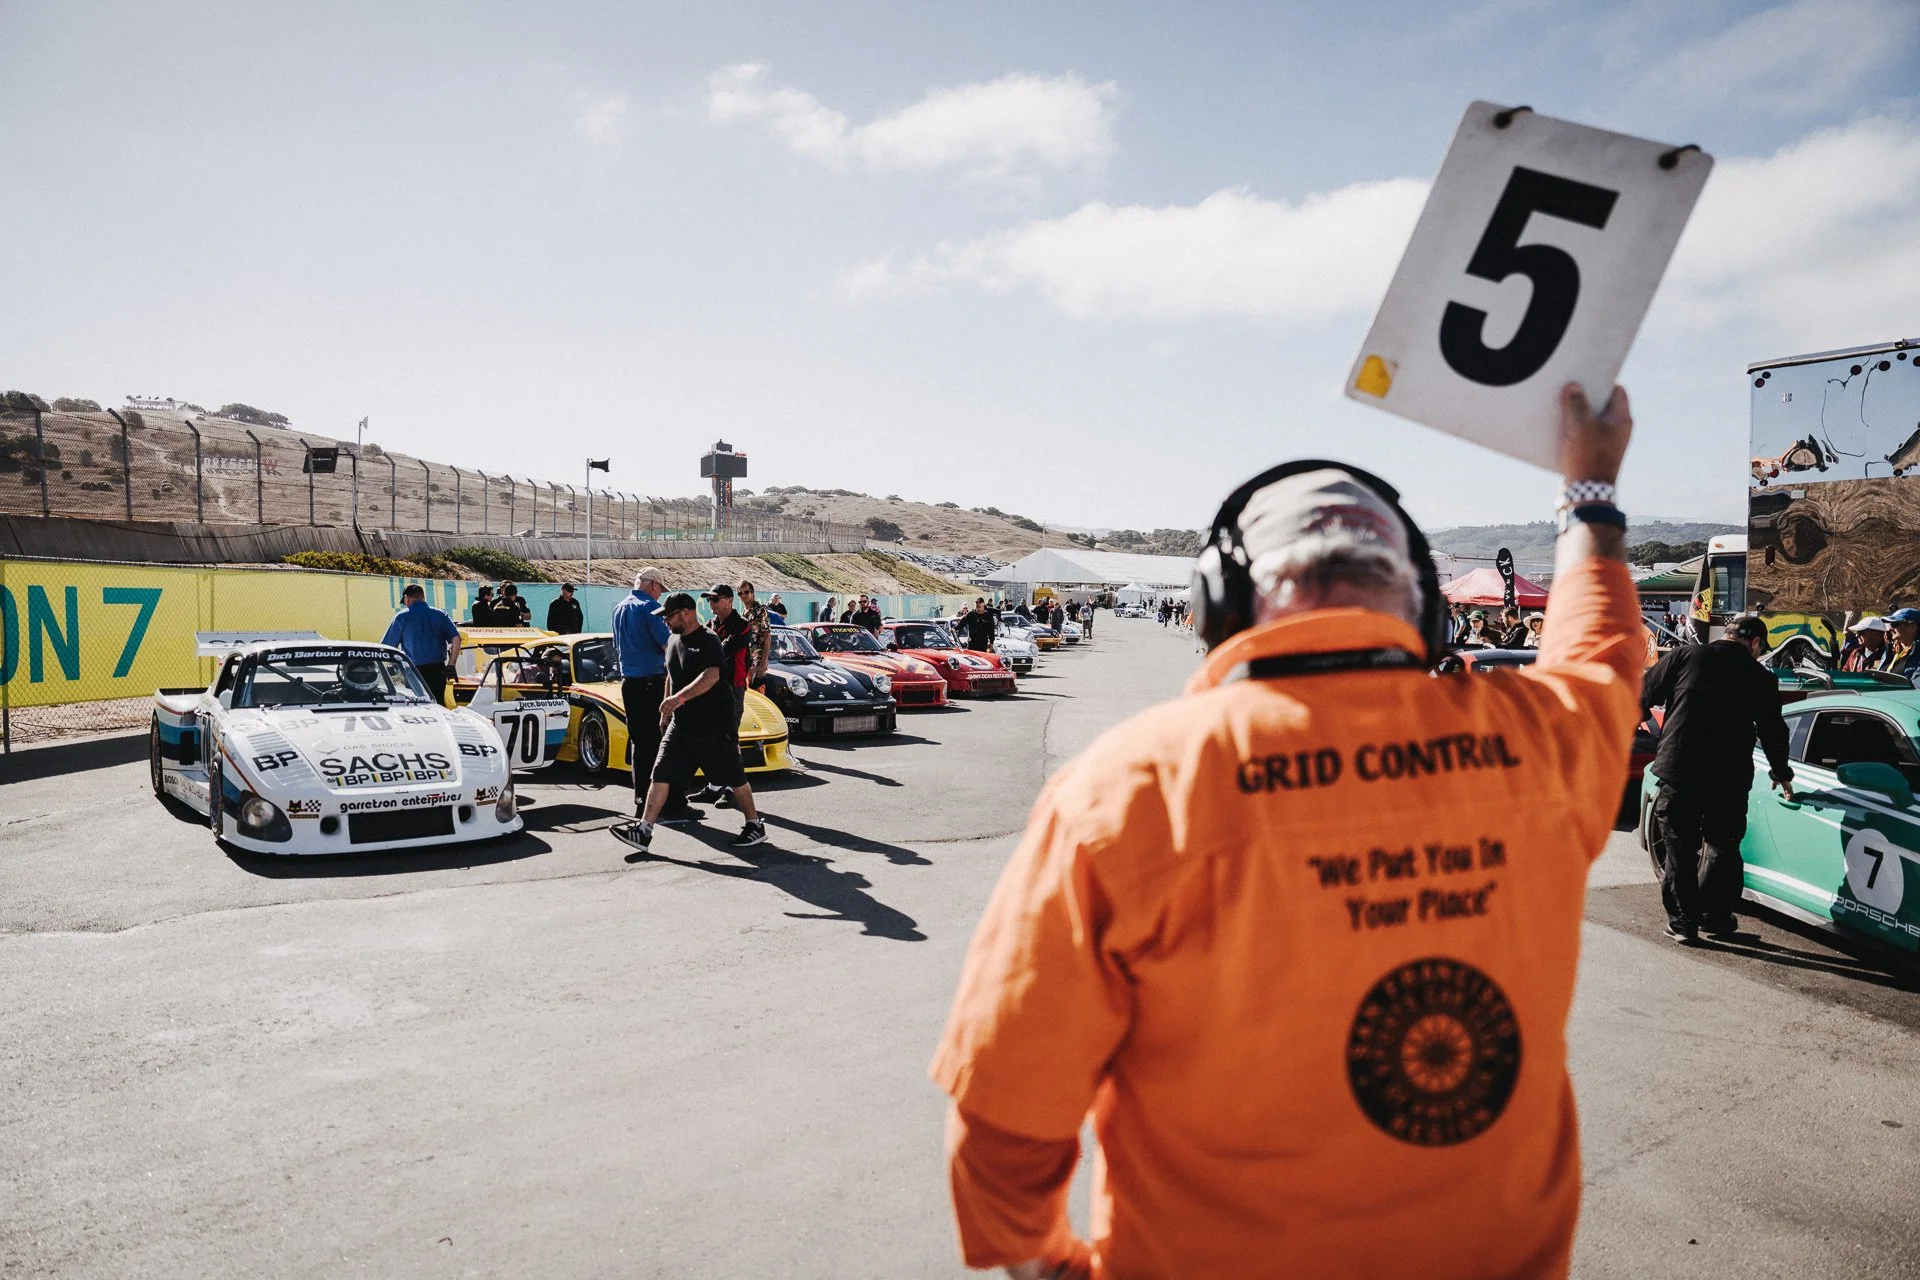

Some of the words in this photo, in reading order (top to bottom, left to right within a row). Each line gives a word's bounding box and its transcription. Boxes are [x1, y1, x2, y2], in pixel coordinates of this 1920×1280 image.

[1439, 165, 1621, 387] 5
[103, 587, 163, 678] 7
[267, 653, 293, 661] Dick
[294, 651, 344, 659] Barbour
[348, 650, 390, 659] RACING
[807, 673, 848, 685] 00
[330, 716, 393, 732] 70
[400, 714, 438, 725] BP
[458, 743, 498, 757] BP
[501, 713, 539, 764] 70
[252, 750, 299, 773] BP
[319, 752, 451, 777] SACHS
[1237, 746, 1343, 793] GRID
[1355, 732, 1522, 782] CONTROL
[345, 774, 370, 786] BP
[379, 771, 405, 783] BP
[415, 770, 438, 781] BP
[340, 799, 397, 813] garretson
[402, 792, 462, 806] enterprises
[1368, 847, 1418, 881] Put
[1424, 842, 1473, 876] You
[1479, 836, 1506, 869] In
[1863, 846, 1884, 889] 7
[1345, 896, 1411, 932] Your
[1832, 893, 1920, 937] PORSCHE
